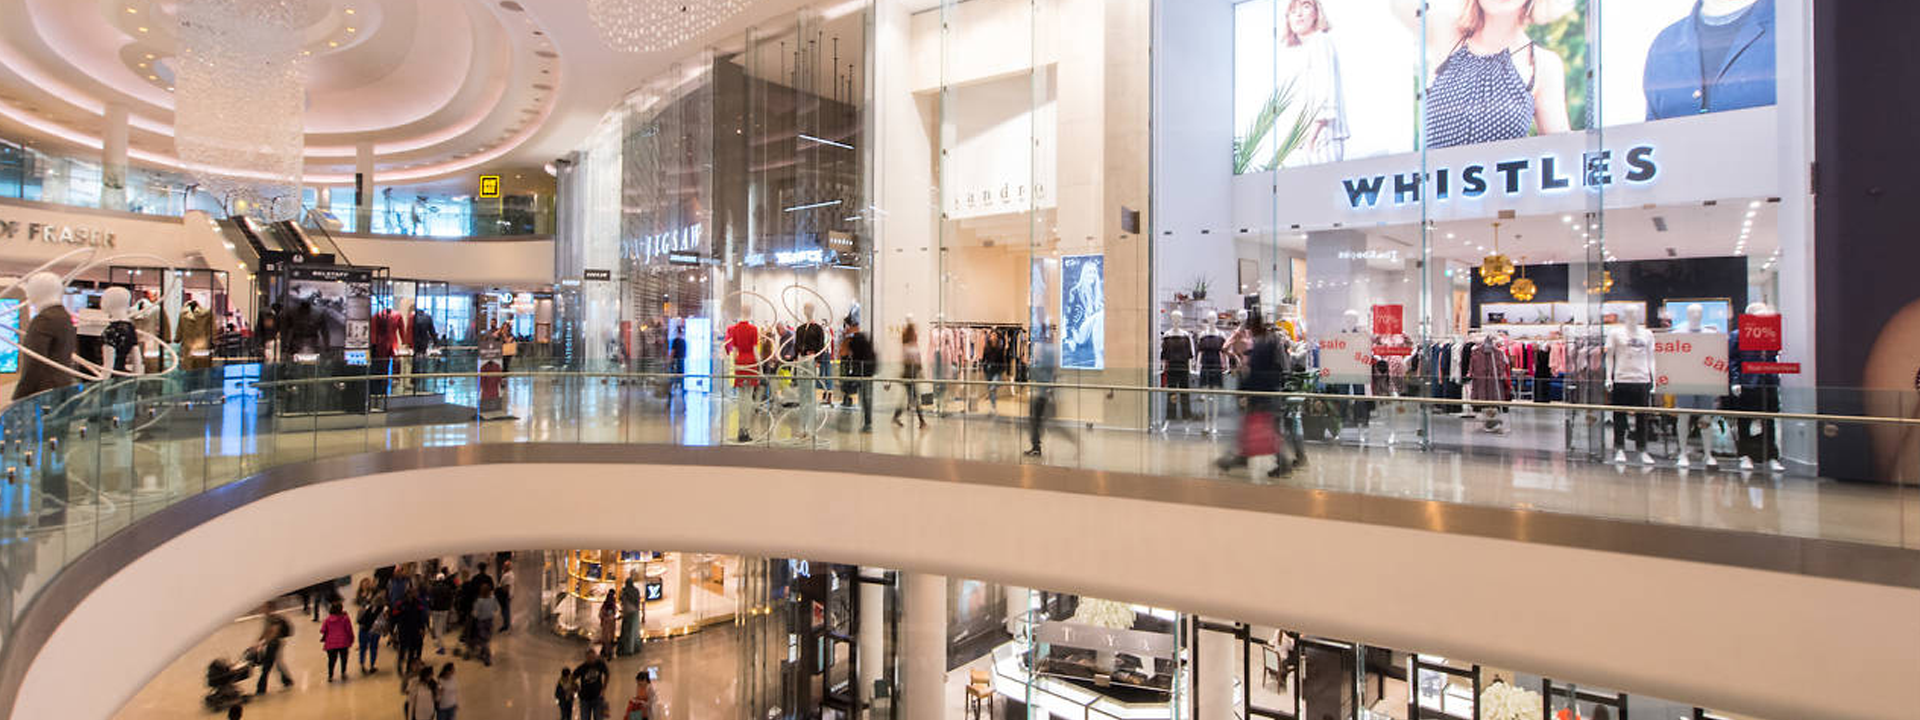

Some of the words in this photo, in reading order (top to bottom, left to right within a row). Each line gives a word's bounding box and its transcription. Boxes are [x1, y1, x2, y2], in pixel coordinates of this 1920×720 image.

[1342, 146, 1658, 207] WHISTLES
[28, 223, 115, 248] FRASER
[645, 223, 702, 265] JIGSAW
[1743, 326, 1776, 339] 70%
[1319, 339, 1346, 350] sale
[1655, 340, 1692, 353] sale
